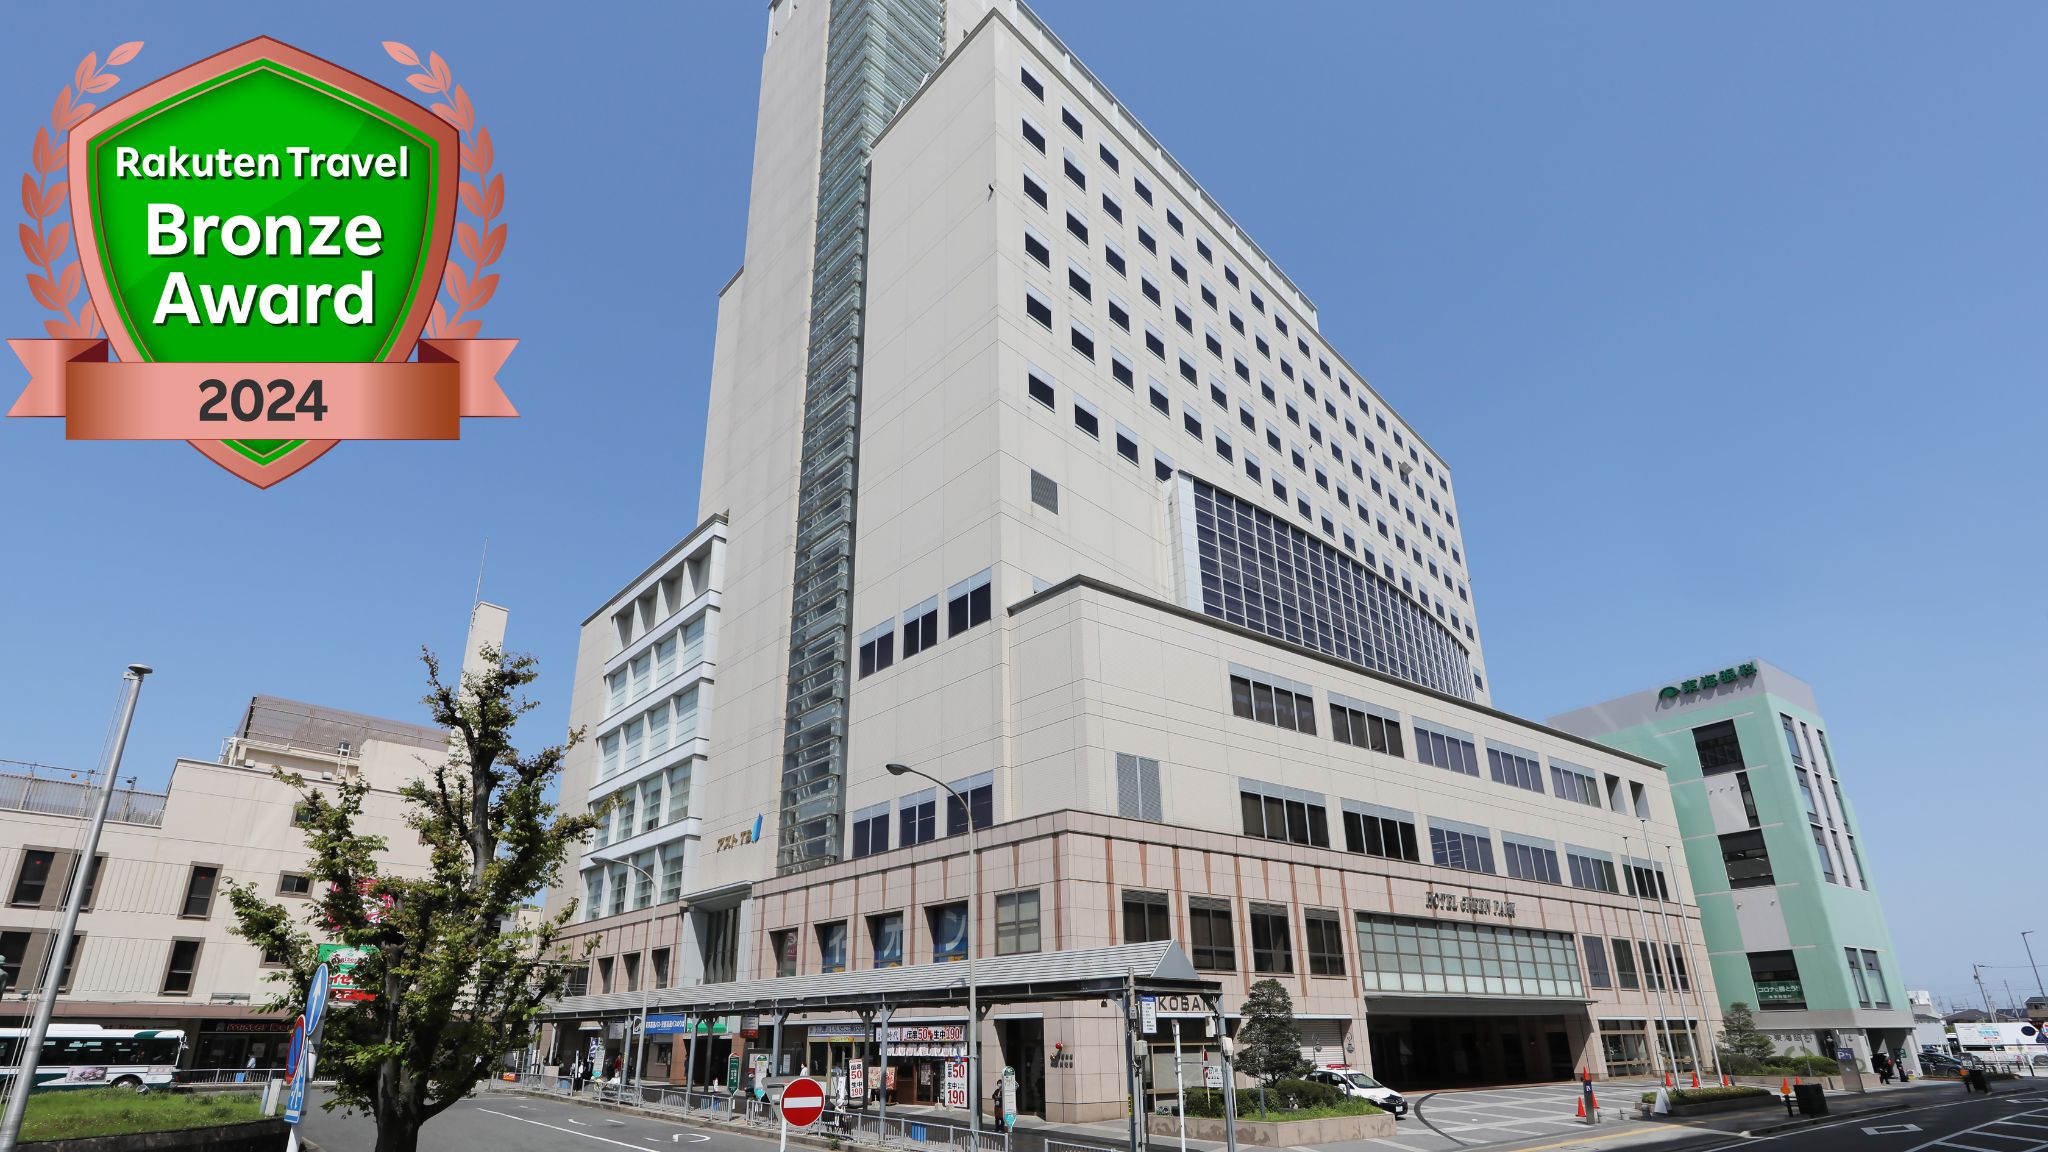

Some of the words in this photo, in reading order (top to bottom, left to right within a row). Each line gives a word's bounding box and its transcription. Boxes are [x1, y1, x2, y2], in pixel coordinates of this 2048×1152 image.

[1681, 662, 1757, 694] 東海眼科
[1426, 891, 1458, 912] HOTEL
[1460, 896, 1490, 915] GREEN
[1493, 900, 1516, 918] PARK
[1837, 1051, 1846, 1060] P
[851, 1070, 863, 1080] 50
[952, 1063, 965, 1079] 50
[947, 1089, 965, 1105] 190
